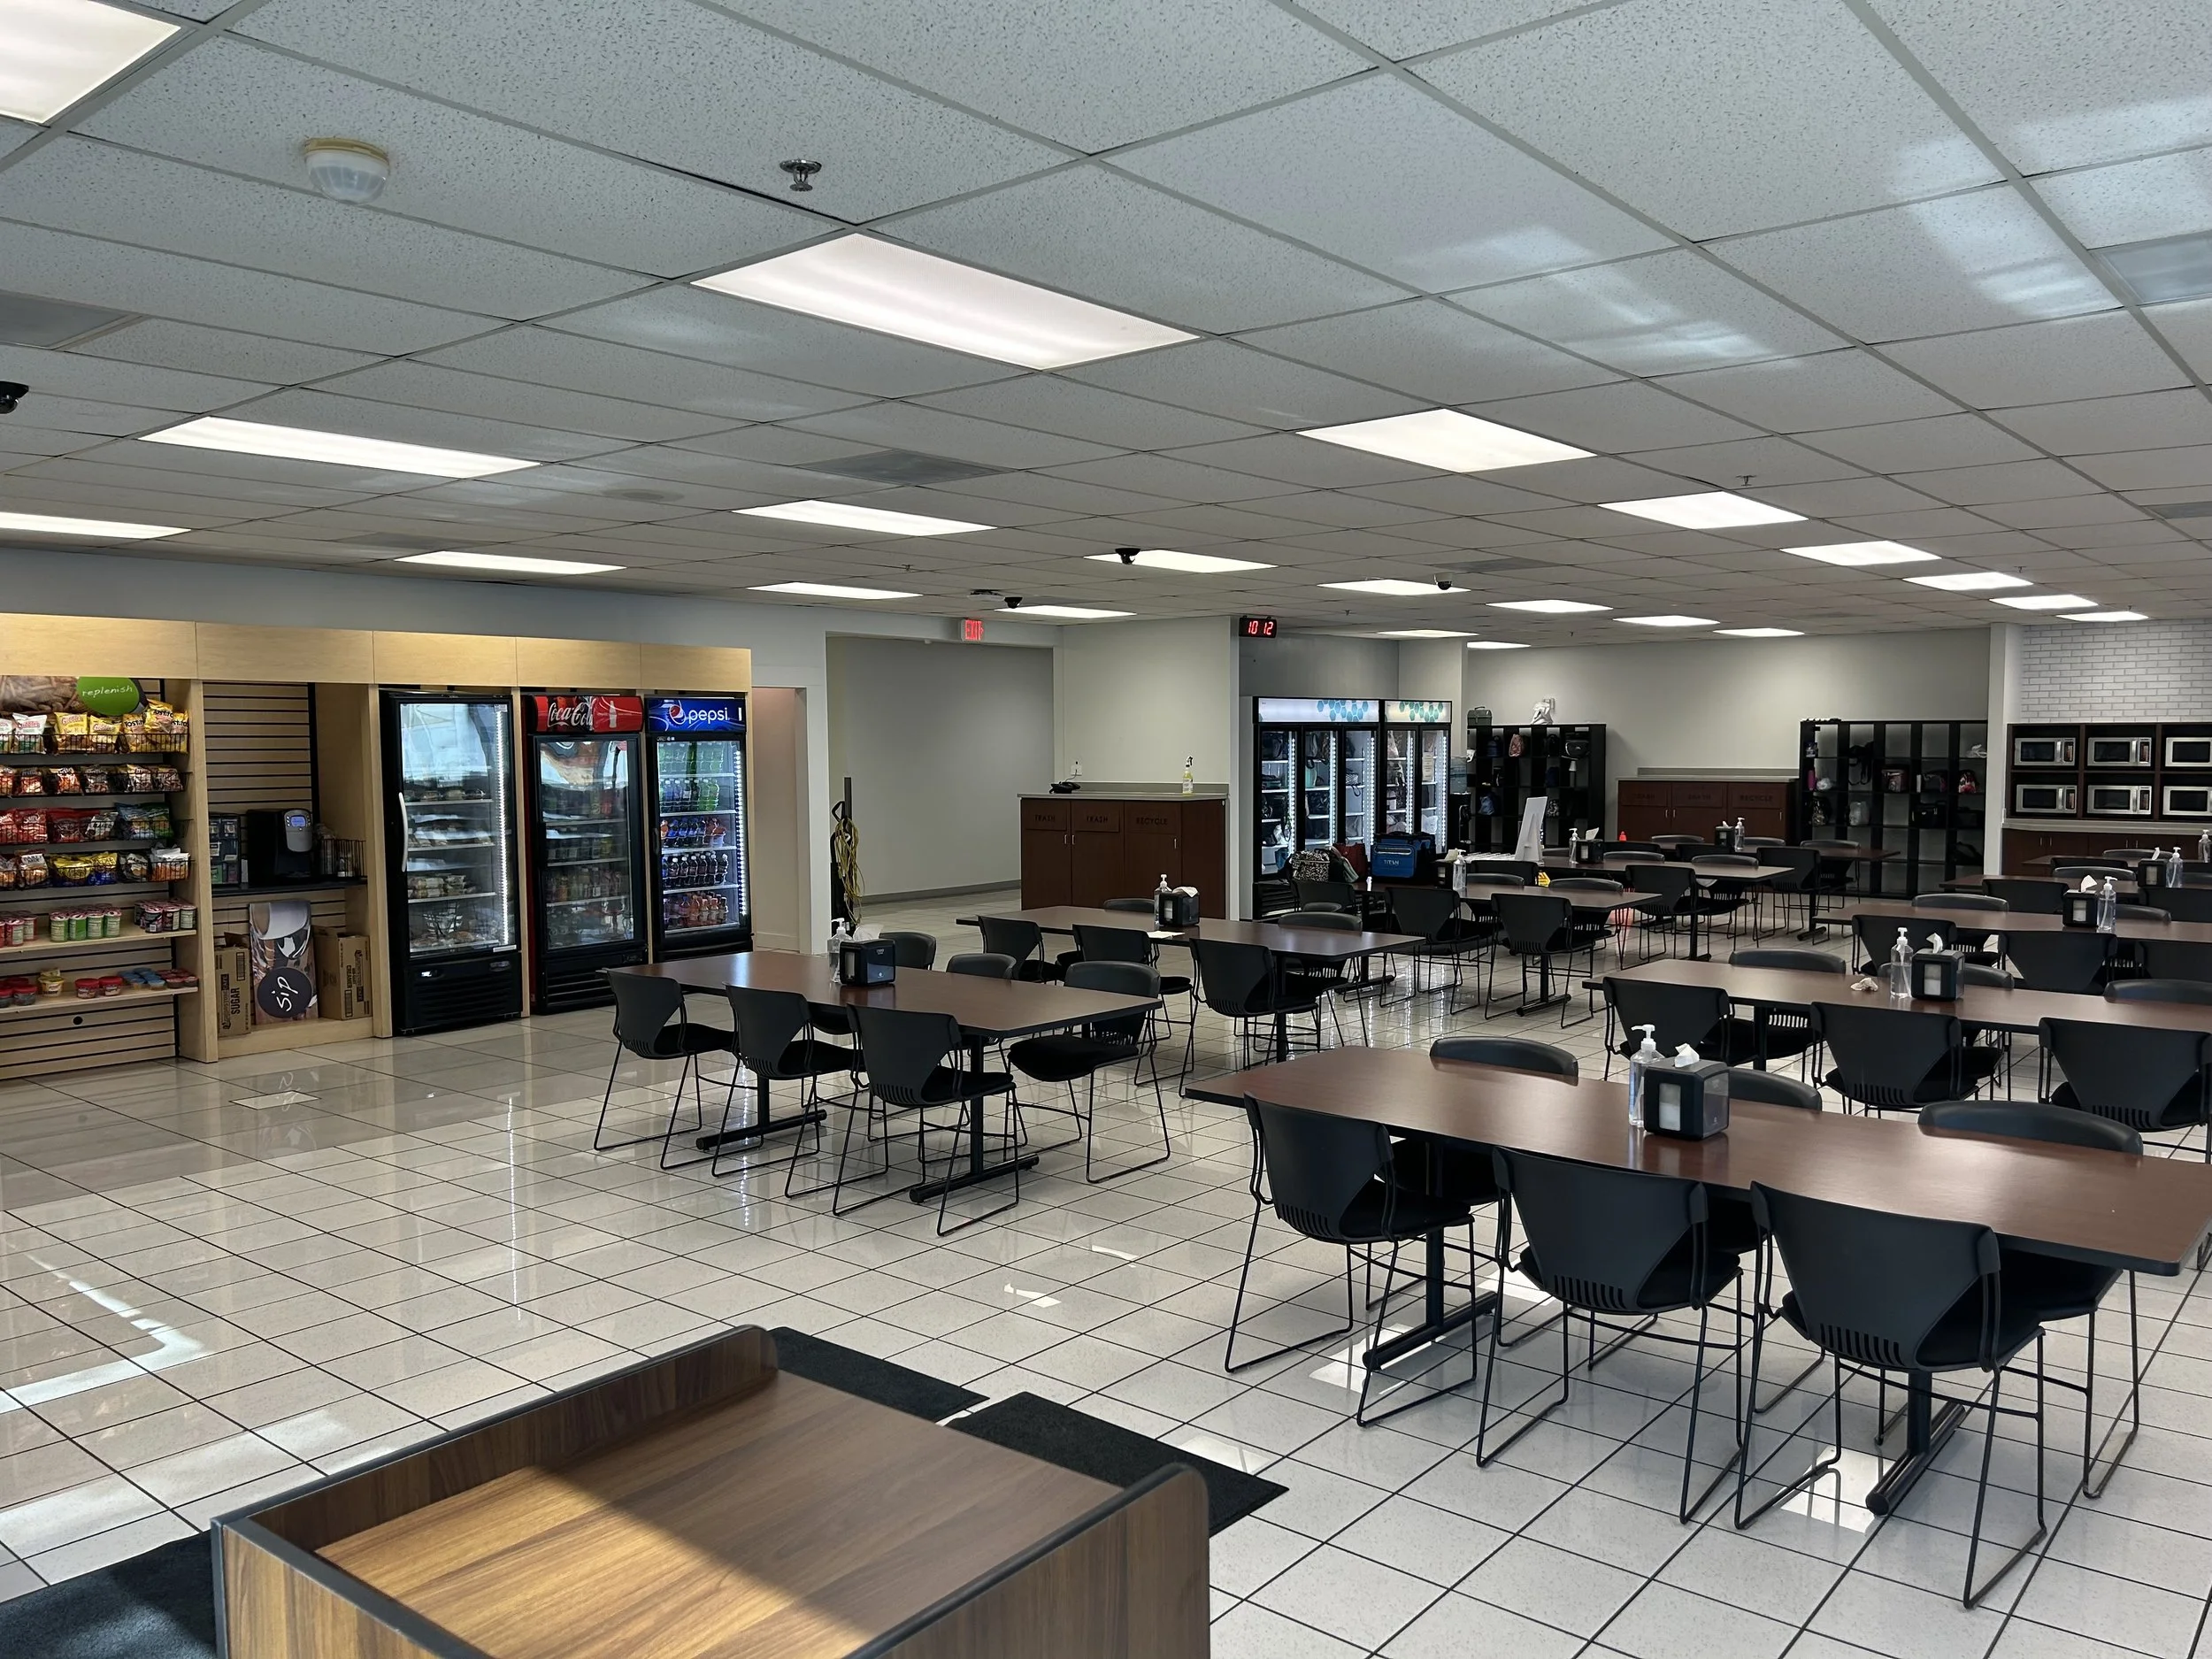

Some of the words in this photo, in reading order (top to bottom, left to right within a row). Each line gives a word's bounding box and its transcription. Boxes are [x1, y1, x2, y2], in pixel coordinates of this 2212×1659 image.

[964, 619, 981, 641] EXIT
[81, 685, 134, 698] replenish
[688, 707, 729, 725] pepsi
[1034, 814, 1056, 823] TRASH
[1086, 815, 1108, 824] TRASH
[1135, 817, 1168, 826] RECYCLE
[231, 987, 241, 1015] SUGAR
[271, 976, 299, 1012] sip
